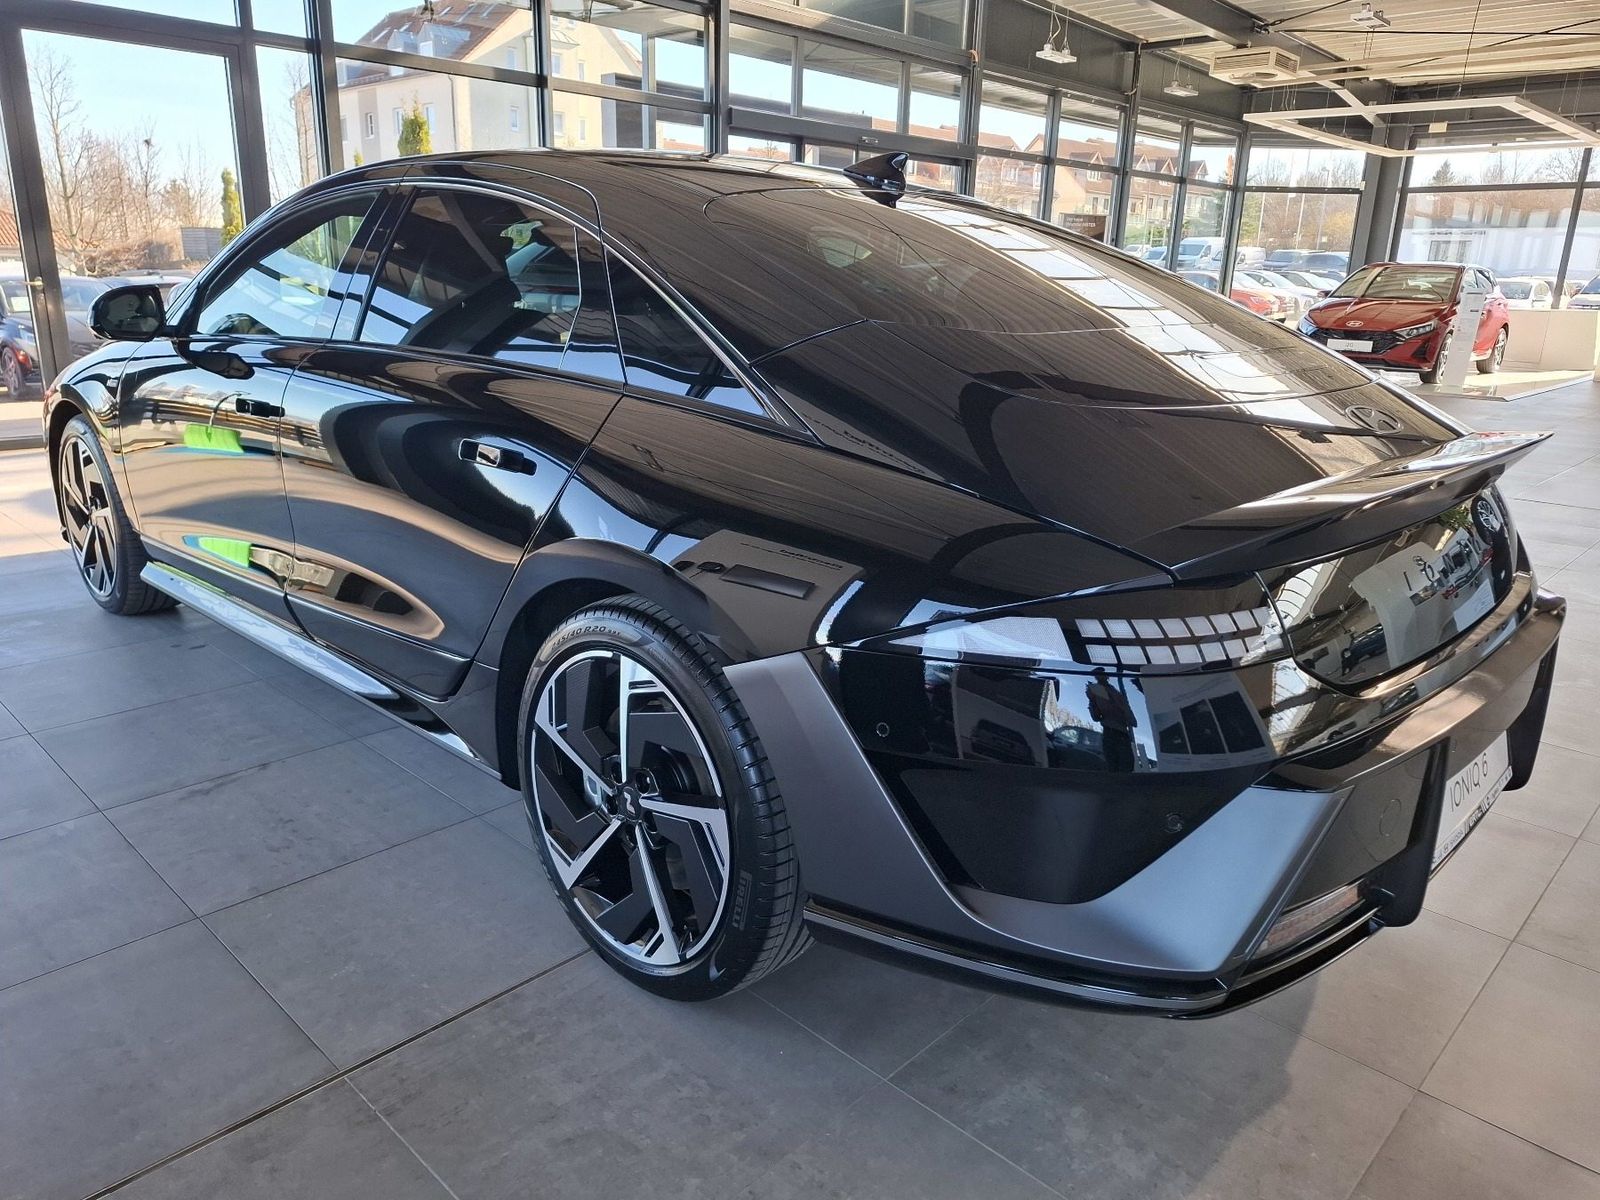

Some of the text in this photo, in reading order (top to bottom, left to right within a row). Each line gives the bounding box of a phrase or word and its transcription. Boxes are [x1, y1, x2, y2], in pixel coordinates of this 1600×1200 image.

[583, 625, 607, 633] R20
[1449, 761, 1480, 812] IONIQ
[1482, 752, 1489, 777] 6
